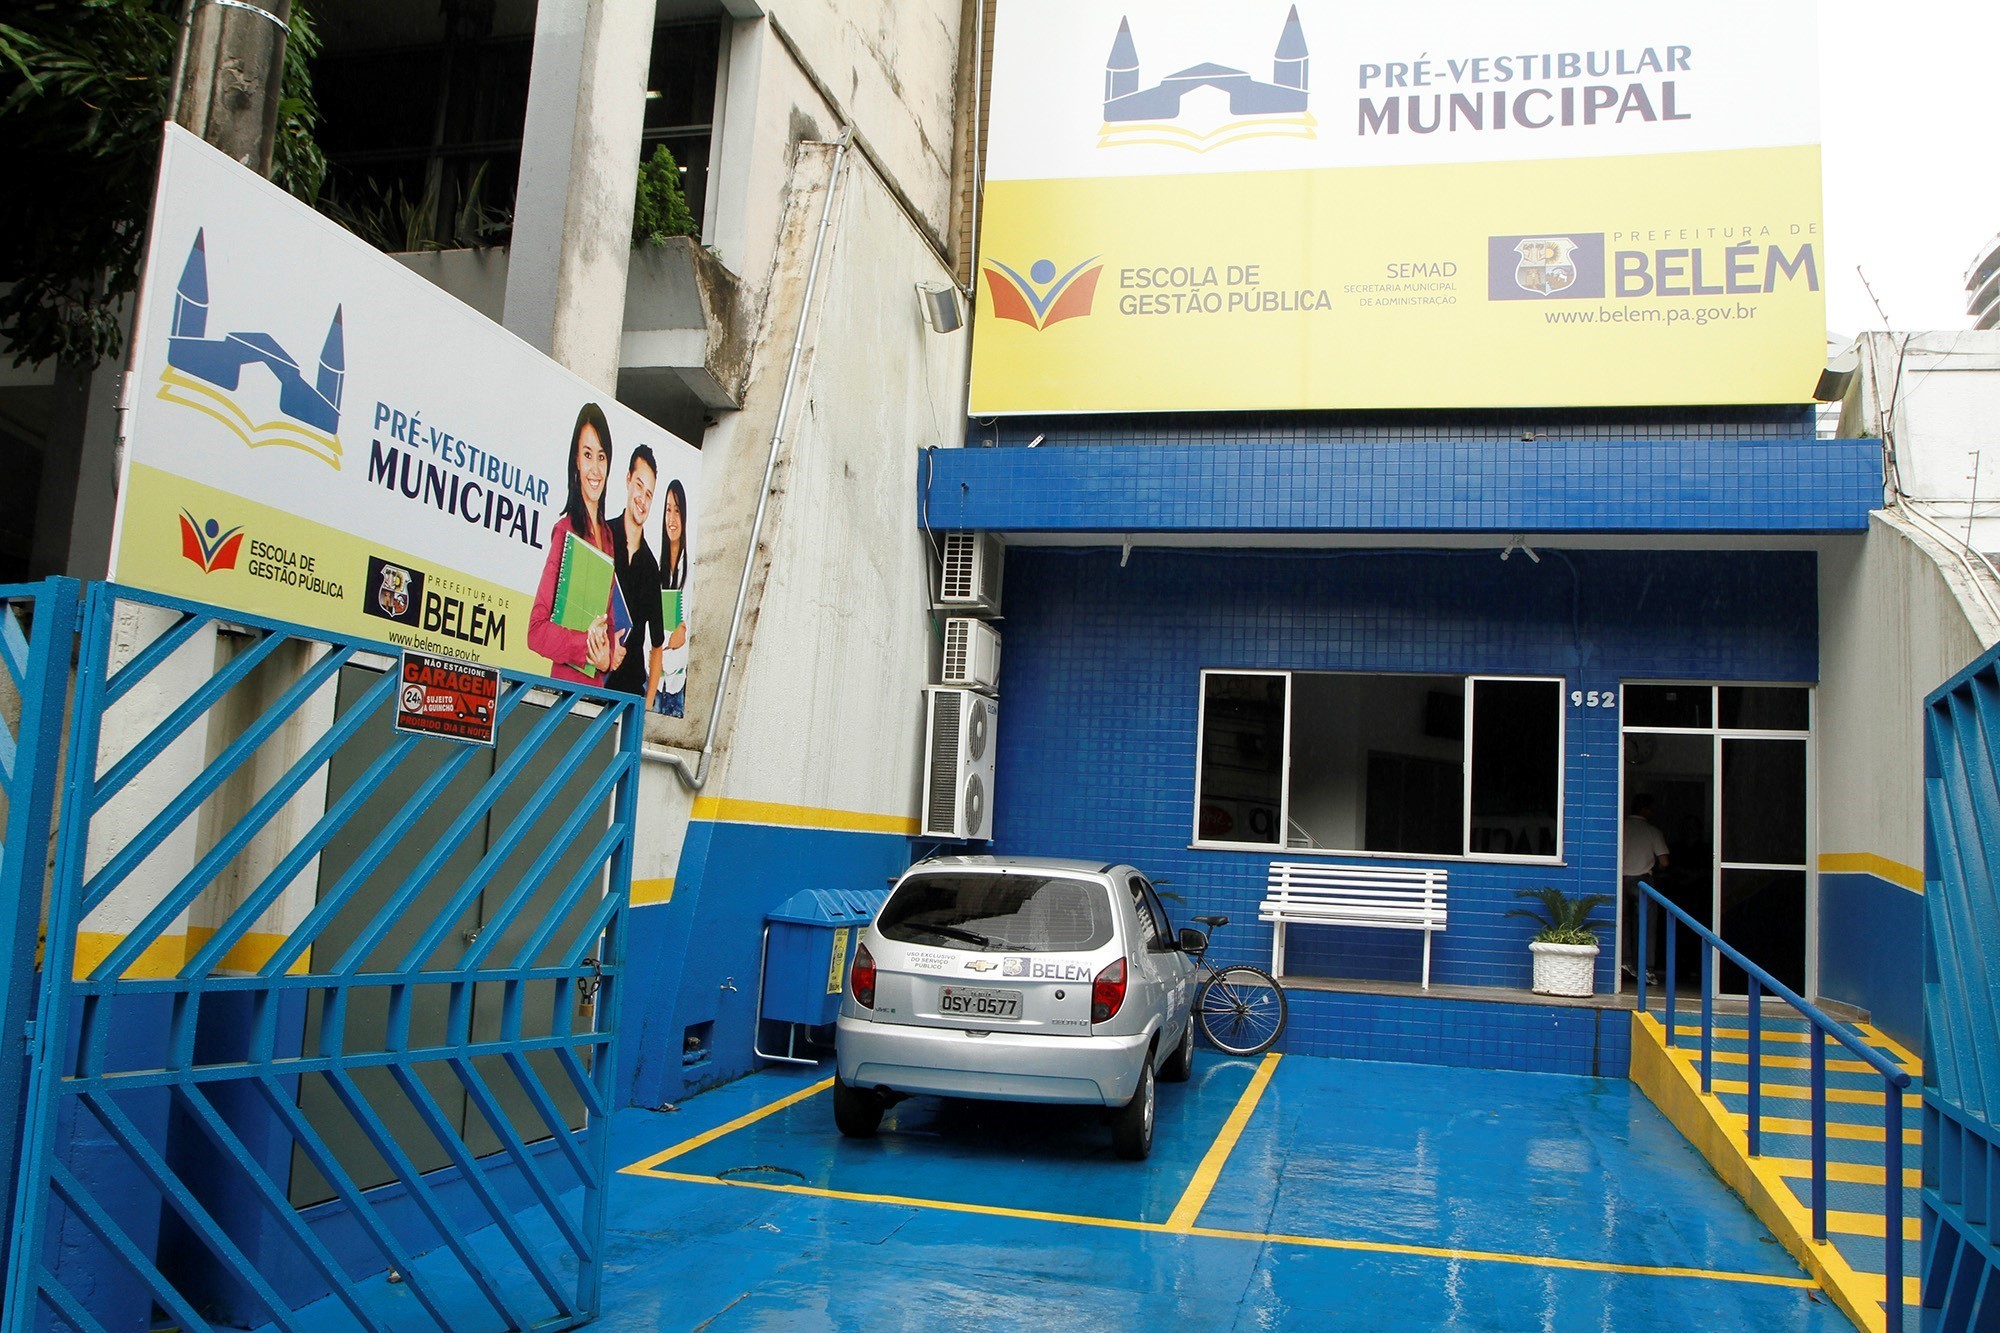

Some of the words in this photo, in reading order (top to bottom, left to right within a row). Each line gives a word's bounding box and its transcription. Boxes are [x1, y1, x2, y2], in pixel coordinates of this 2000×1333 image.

[1358, 45, 1692, 89] PRÉ-VESTIBULAR
[1358, 81, 1692, 136] MUNICIPAL
[1613, 226, 1770, 242] PREFEITURA
[1790, 223, 1817, 235] DE
[1119, 266, 1218, 289] ESCOLA
[1226, 265, 1260, 286] DE
[1387, 262, 1457, 279] SEMAD
[1614, 240, 1820, 299] BELÉM
[1343, 284, 1402, 293] SECRETARIA
[1403, 282, 1457, 292] MUNICIPAL
[1119, 289, 1222, 316] GESTÃO
[1227, 287, 1332, 313] PÚBLICA
[1360, 298, 1373, 307] DE
[1545, 303, 1757, 325] www.belem.pa.gov.br
[373, 401, 550, 507] PRÉ-VESTIBULAR
[368, 438, 543, 550] MUNICIPAL
[250, 540, 297, 567] ESCOLA
[299, 555, 315, 573] DE
[248, 559, 297, 587] GESTÃO
[298, 574, 344, 600] PÚBLICA
[428, 574, 492, 604] PREFEITURA
[498, 597, 510, 610] DE
[423, 590, 506, 652] BELÉM
[389, 631, 480, 663] www.belem.pa.gov.br
[404, 662, 496, 697] GARAGEM
[424, 659, 442, 669] NÃO
[443, 663, 486, 678] ESTACIONE
[423, 704, 428, 712] A
[426, 695, 453, 704] SUJEITO
[1571, 690, 1615, 708] 952
[399, 715, 441, 730] PROIBIDO
[443, 723, 458, 733] DIA
[460, 725, 467, 735] E
[467, 727, 491, 738] NOITE
[1032, 963, 1092, 982] BELÉM
